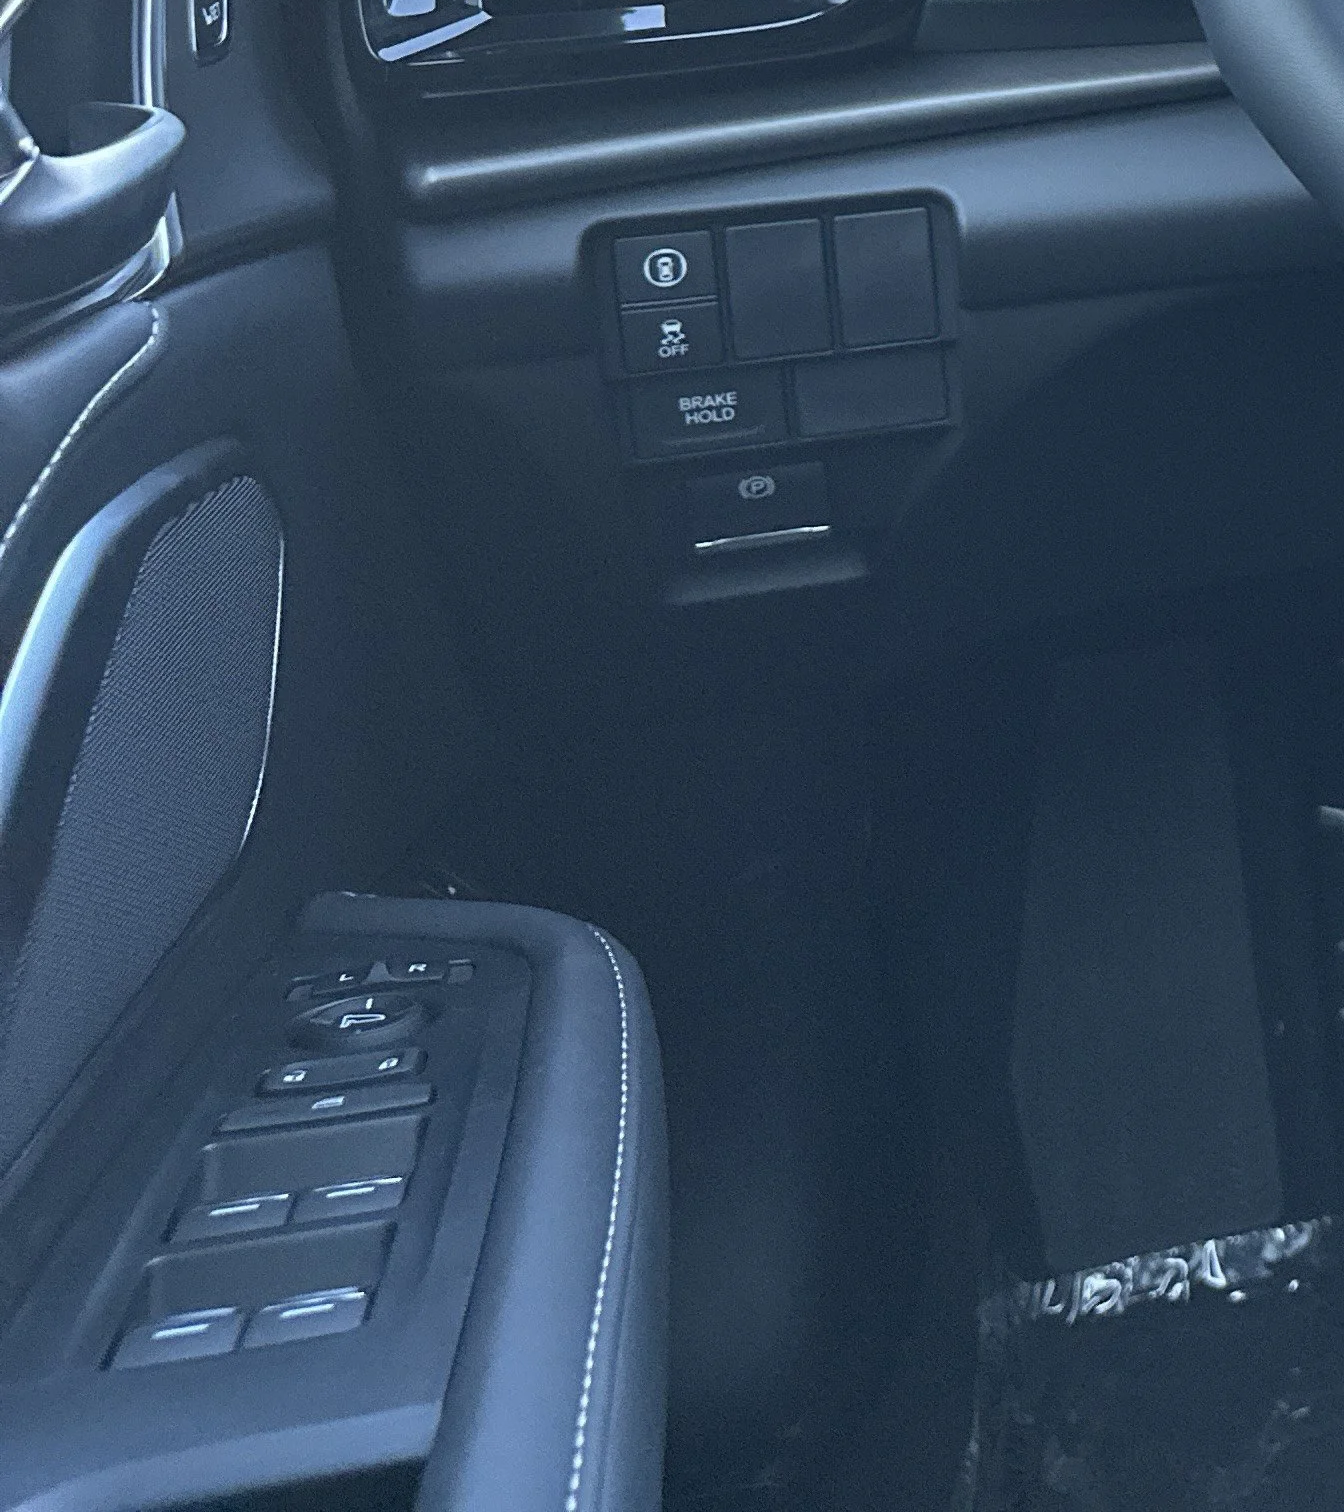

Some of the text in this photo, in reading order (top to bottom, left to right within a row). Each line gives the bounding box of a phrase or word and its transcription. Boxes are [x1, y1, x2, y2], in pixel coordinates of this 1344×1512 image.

[657, 343, 689, 358] OFF
[679, 391, 738, 412] BRAKE
[684, 406, 735, 426] HOLD
